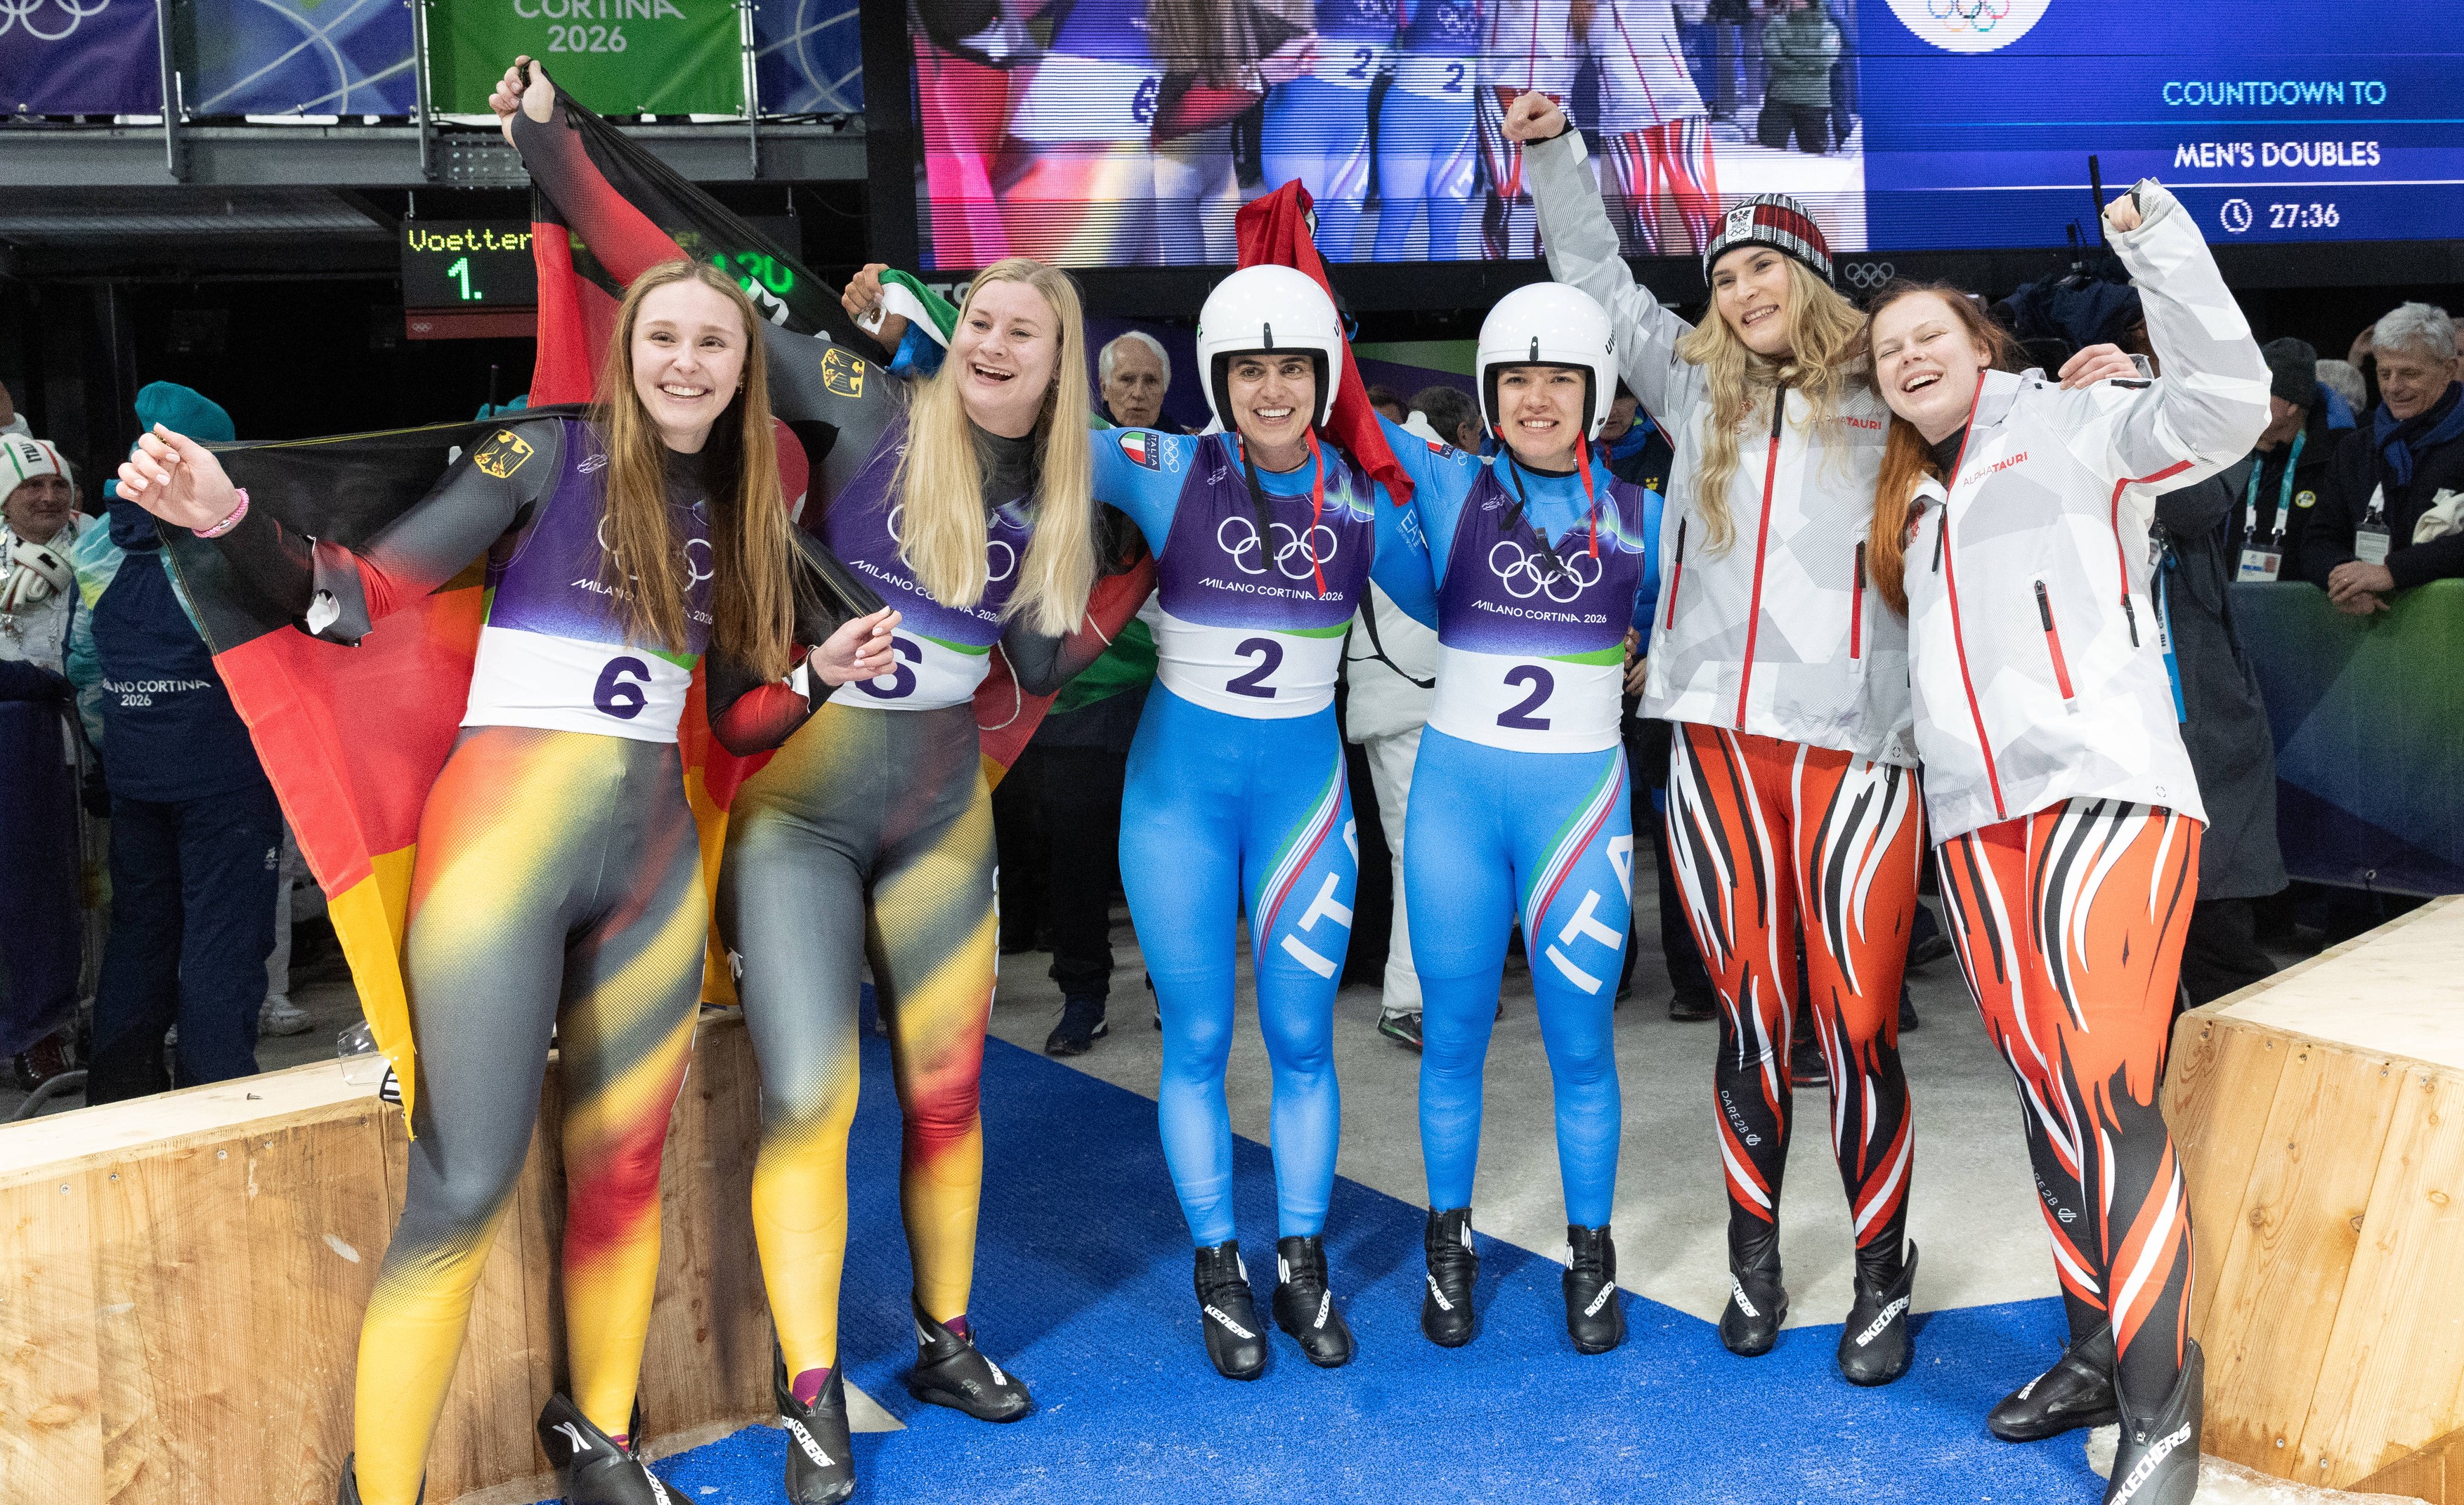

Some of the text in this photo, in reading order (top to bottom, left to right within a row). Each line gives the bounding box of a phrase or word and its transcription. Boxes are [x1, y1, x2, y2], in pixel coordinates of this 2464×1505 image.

[514, 0, 686, 20] CORTINA
[547, 25, 627, 53] 2026
[1345, 48, 1372, 79] 2
[1442, 61, 1465, 93] 2
[2162, 82, 2387, 105] COUNTDOWN TO
[2174, 141, 2380, 168] MEN'S DOUBLES
[2269, 203, 2340, 228] 27:36
[409, 229, 533, 252] Voetter
[448, 257, 482, 300] 1.
[1962, 451, 2028, 488] ALPHATAURI
[849, 560, 913, 591] MILANO
[1198, 577, 1343, 601] MILANO CORTINA 2026
[693, 610, 713, 625] 2026
[1471, 599, 1608, 623] MILANO CORTINA 2026
[1225, 637, 1284, 698] 2
[121, 694, 152, 706] 2026
[136, 680, 211, 692] CORTINA
[593, 656, 652, 719] 6
[1496, 665, 1555, 731] 2
[1721, 1090, 1749, 1133] DARE2B
[1856, 1294, 1910, 1348] SKECHERS
